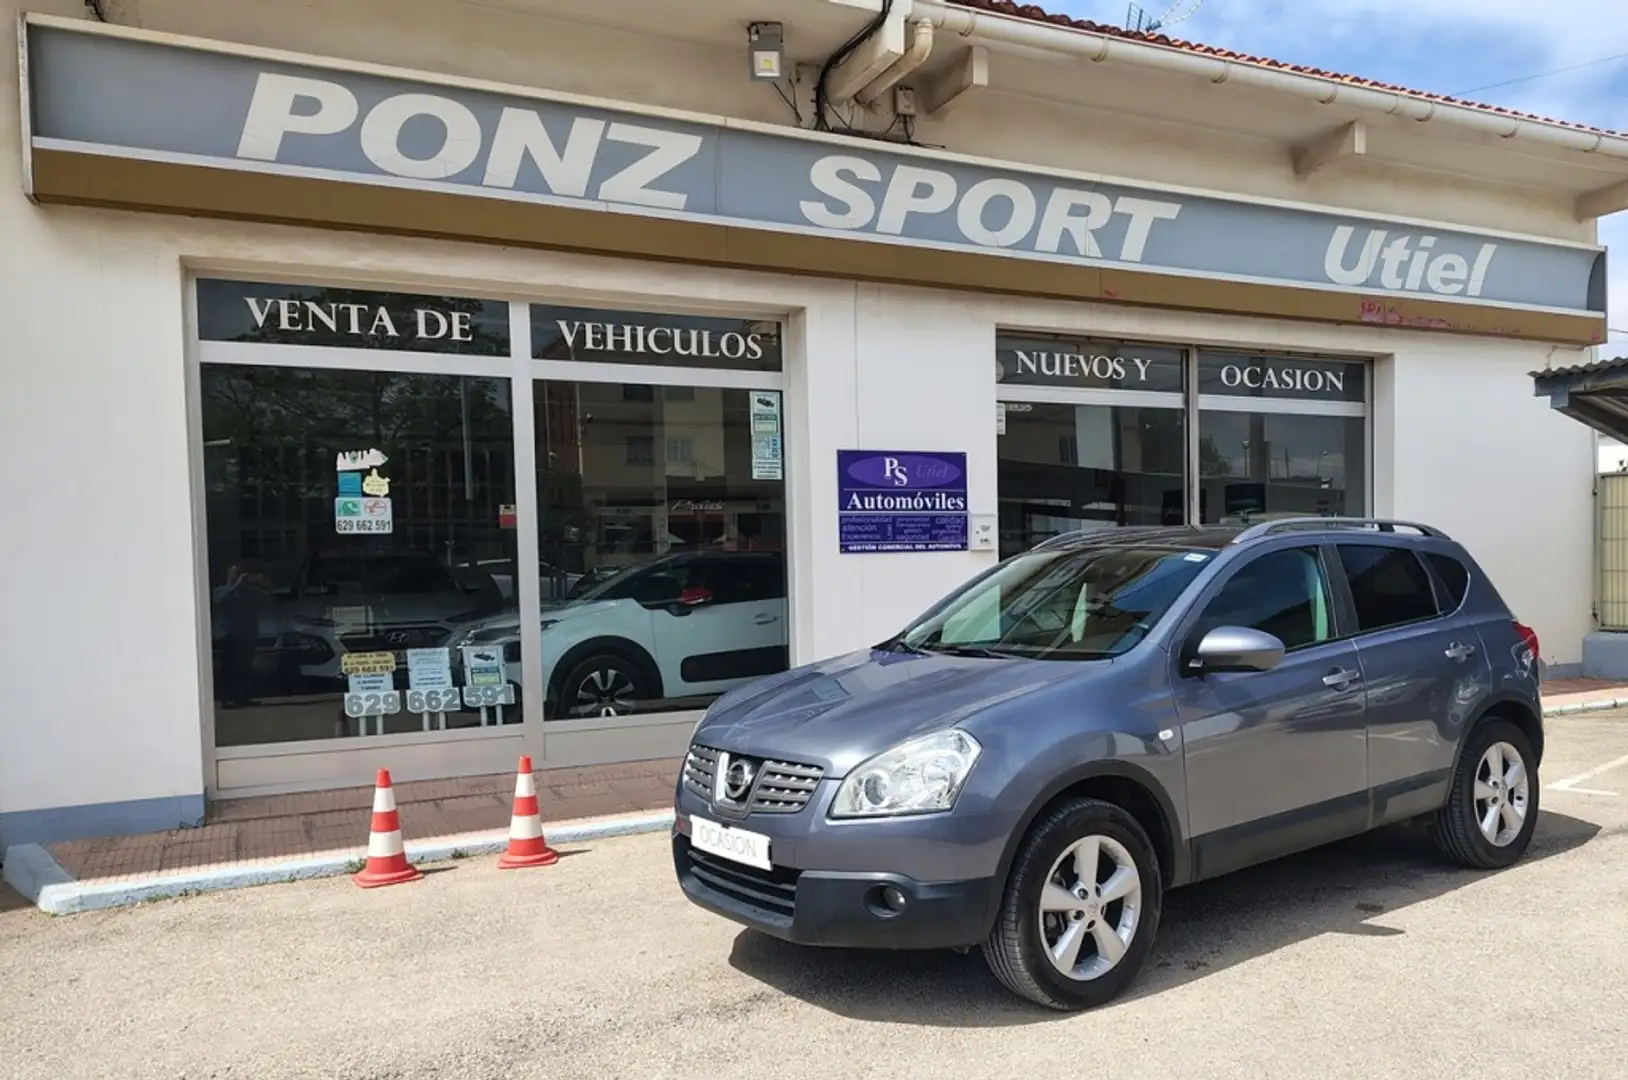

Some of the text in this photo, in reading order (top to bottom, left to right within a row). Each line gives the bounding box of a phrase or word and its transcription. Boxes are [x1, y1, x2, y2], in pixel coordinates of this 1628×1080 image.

[236, 72, 1498, 297] PONZ SPORT Utiel
[244, 297, 473, 342] VENTA DE
[556, 319, 763, 361] VEHICULOS
[1014, 350, 1153, 382] NUEVOS Y
[1220, 365, 1345, 393] OCASION
[916, 464, 948, 479] Utiel
[847, 492, 964, 509] Automóviles
[337, 520, 391, 531] 629 662 591
[878, 543, 914, 551] COMERCIAL
[346, 693, 400, 716] 629
[408, 689, 460, 712] 662
[464, 686, 514, 706] 591
[700, 824, 757, 857] OCASION
